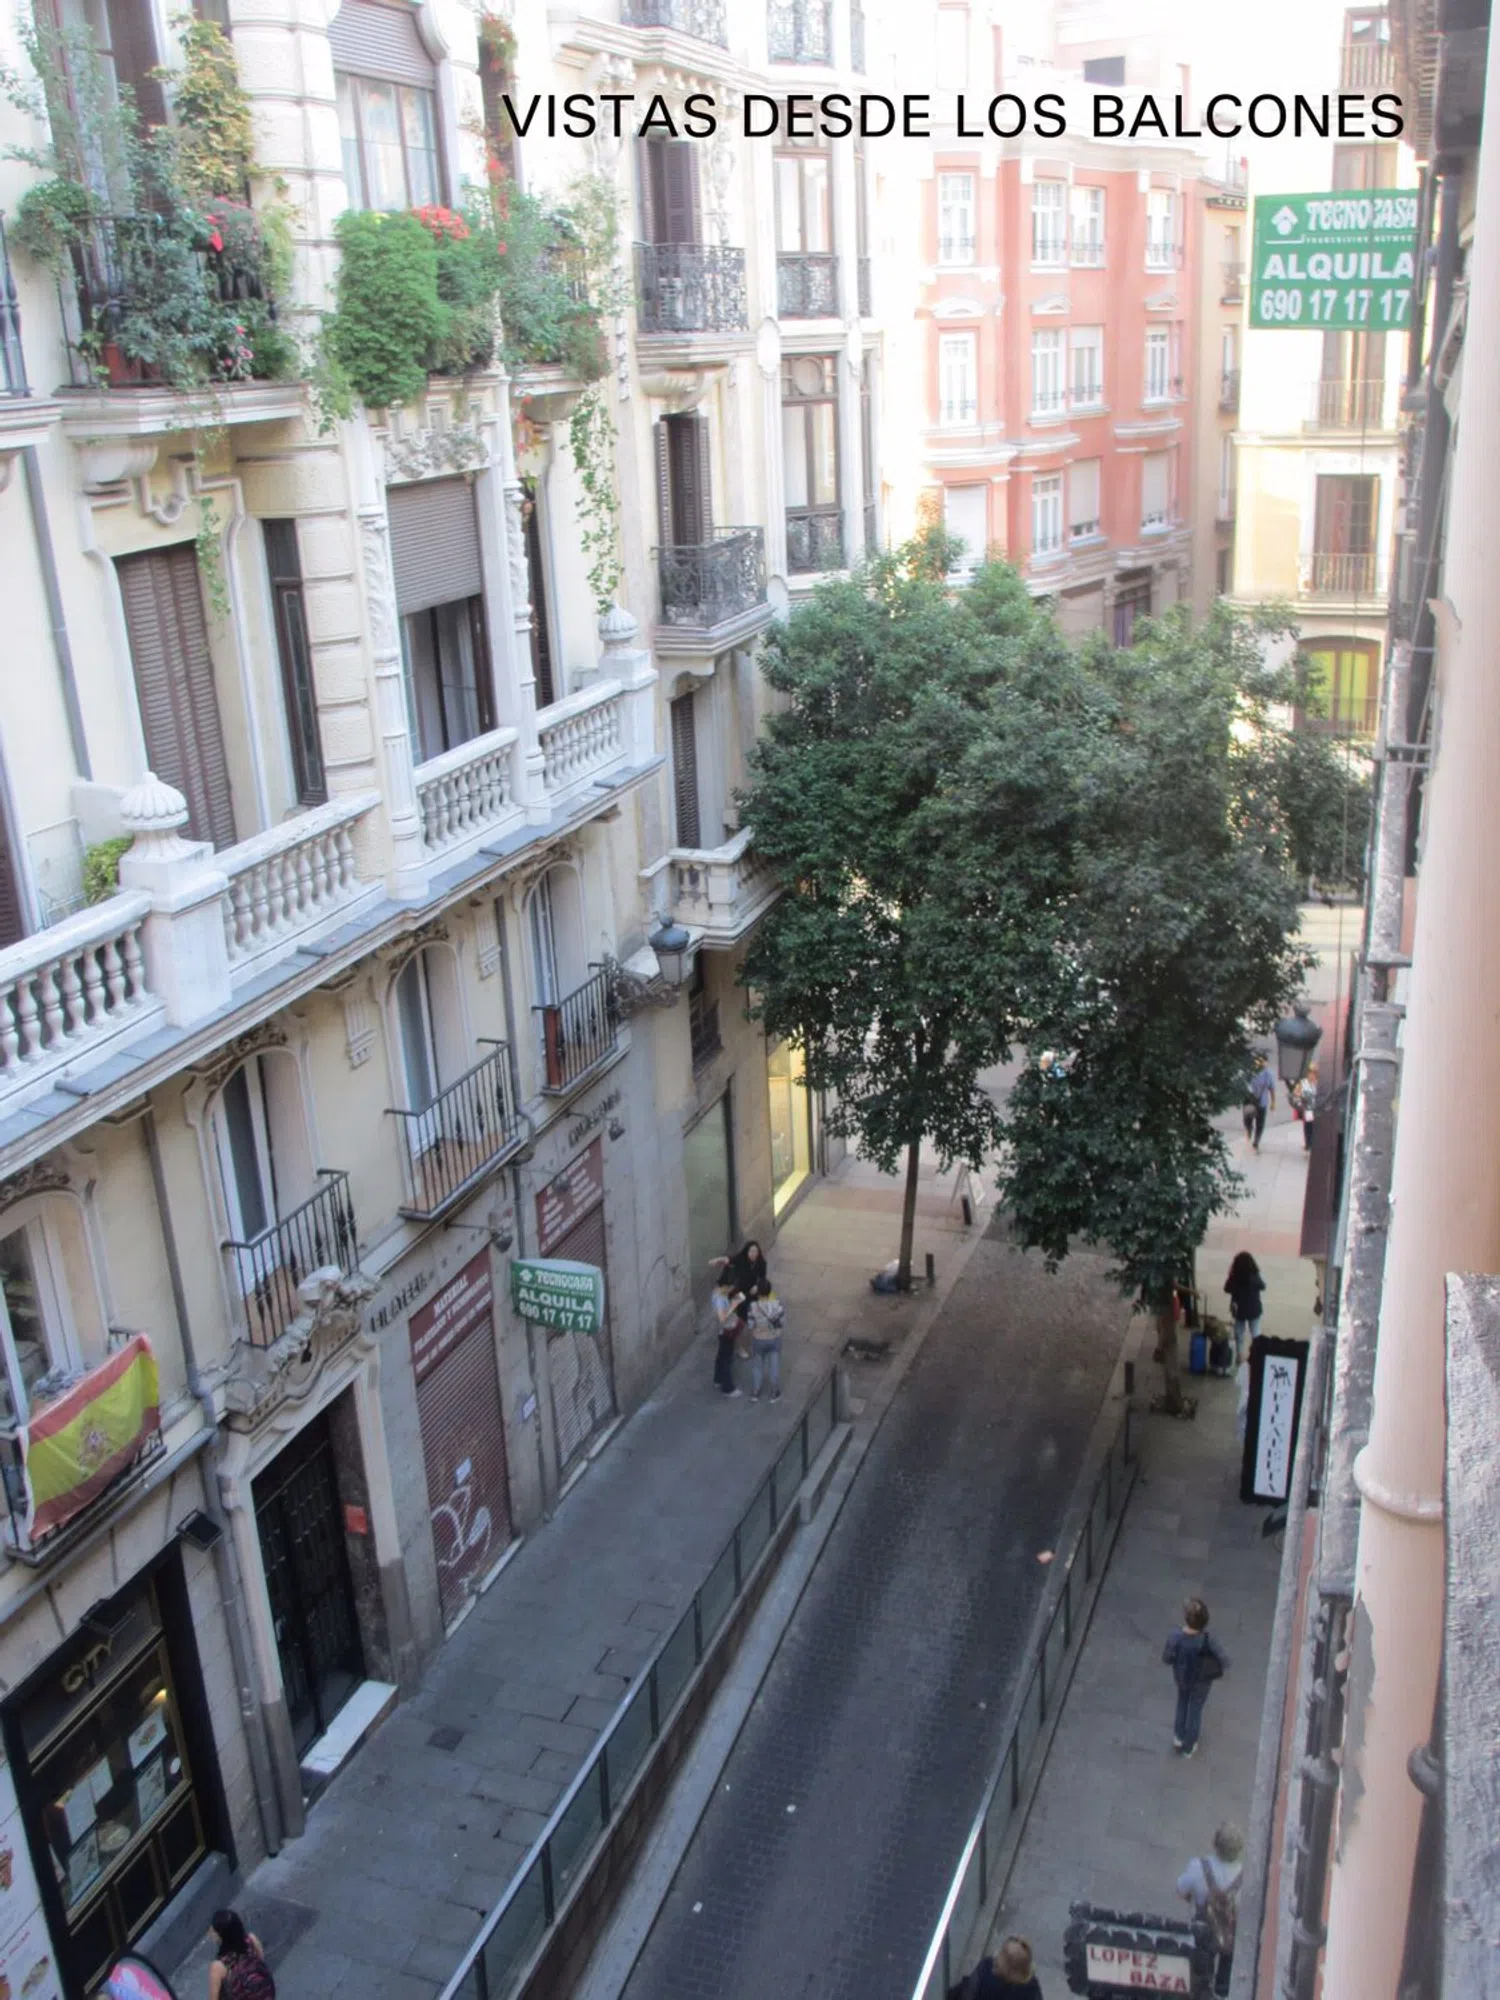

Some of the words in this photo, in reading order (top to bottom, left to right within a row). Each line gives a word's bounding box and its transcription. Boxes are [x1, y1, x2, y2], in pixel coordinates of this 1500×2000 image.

[1262, 253, 1415, 281] ALQUILA
[1260, 288, 1302, 321] 690
[1310, 289, 1338, 321] 17
[1344, 289, 1373, 321] 17
[1380, 289, 1411, 321] 17
[519, 1288, 594, 1313] ALQUILA
[542, 1307, 556, 1325] 17
[560, 1311, 574, 1327] 17
[578, 1314, 593, 1330] 17
[61, 1636, 112, 1692] CITY
[1088, 1946, 1158, 1970] LOPEZ
[1130, 1970, 1188, 1993] BAZA
